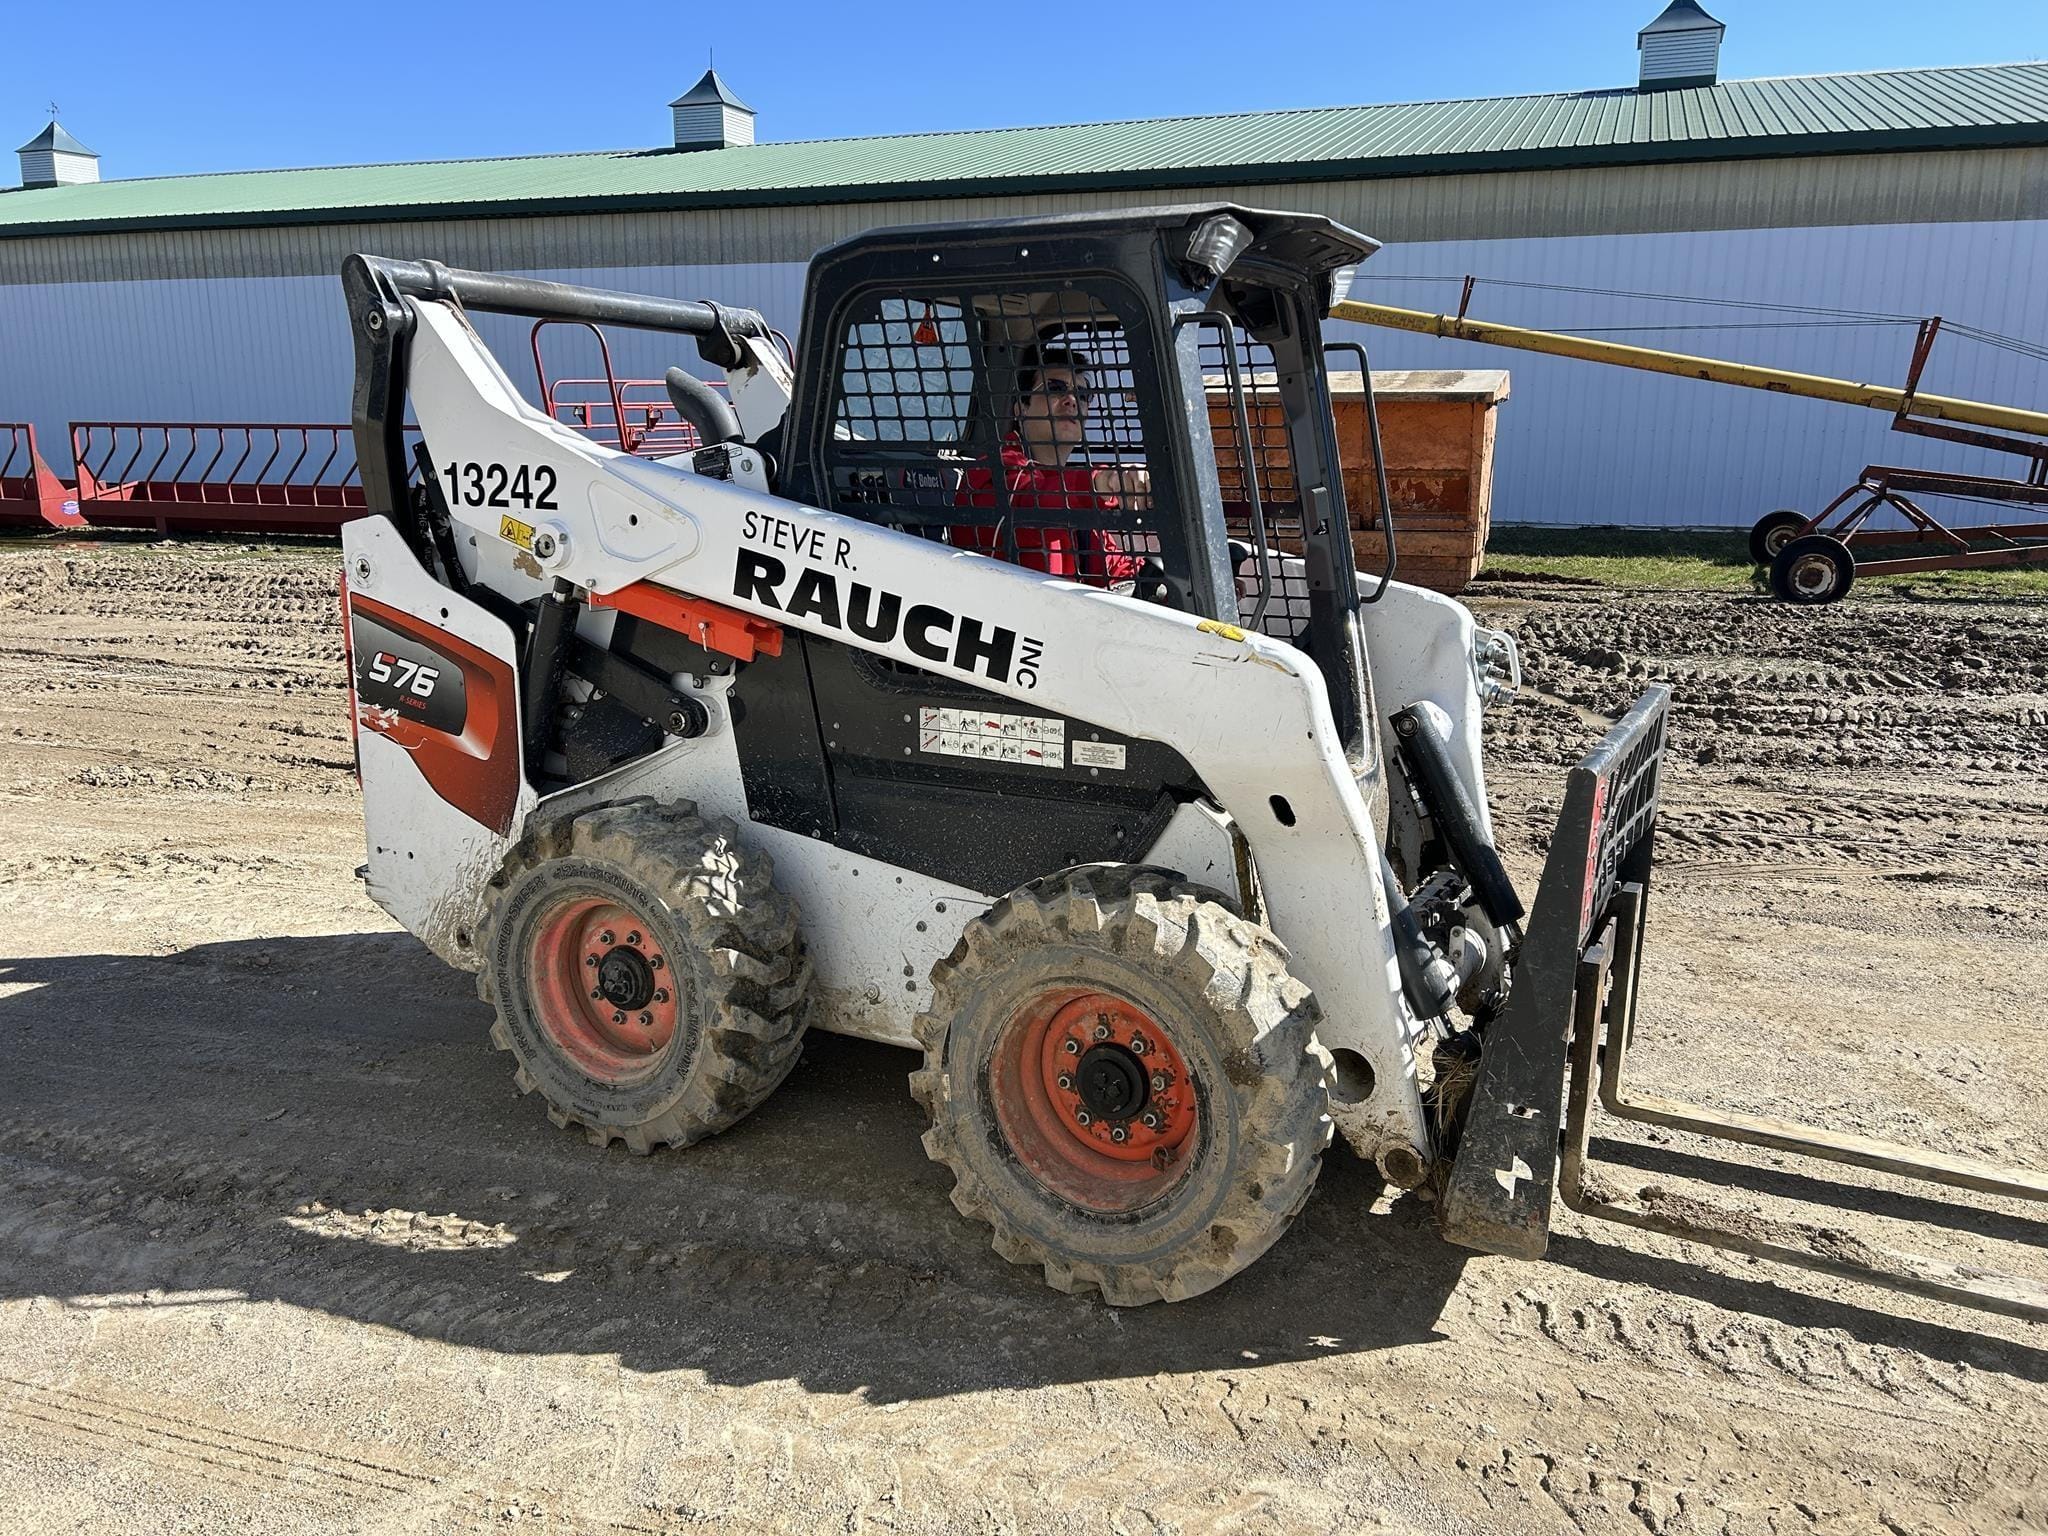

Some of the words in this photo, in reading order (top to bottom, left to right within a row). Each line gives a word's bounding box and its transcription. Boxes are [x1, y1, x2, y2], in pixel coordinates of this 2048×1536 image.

[443, 461, 558, 511] 13242
[742, 510, 826, 561] STEVE
[834, 537, 858, 572] R.
[733, 546, 1017, 683] RAUCH
[368, 652, 440, 698] S76
[1016, 636, 1044, 690] INC
